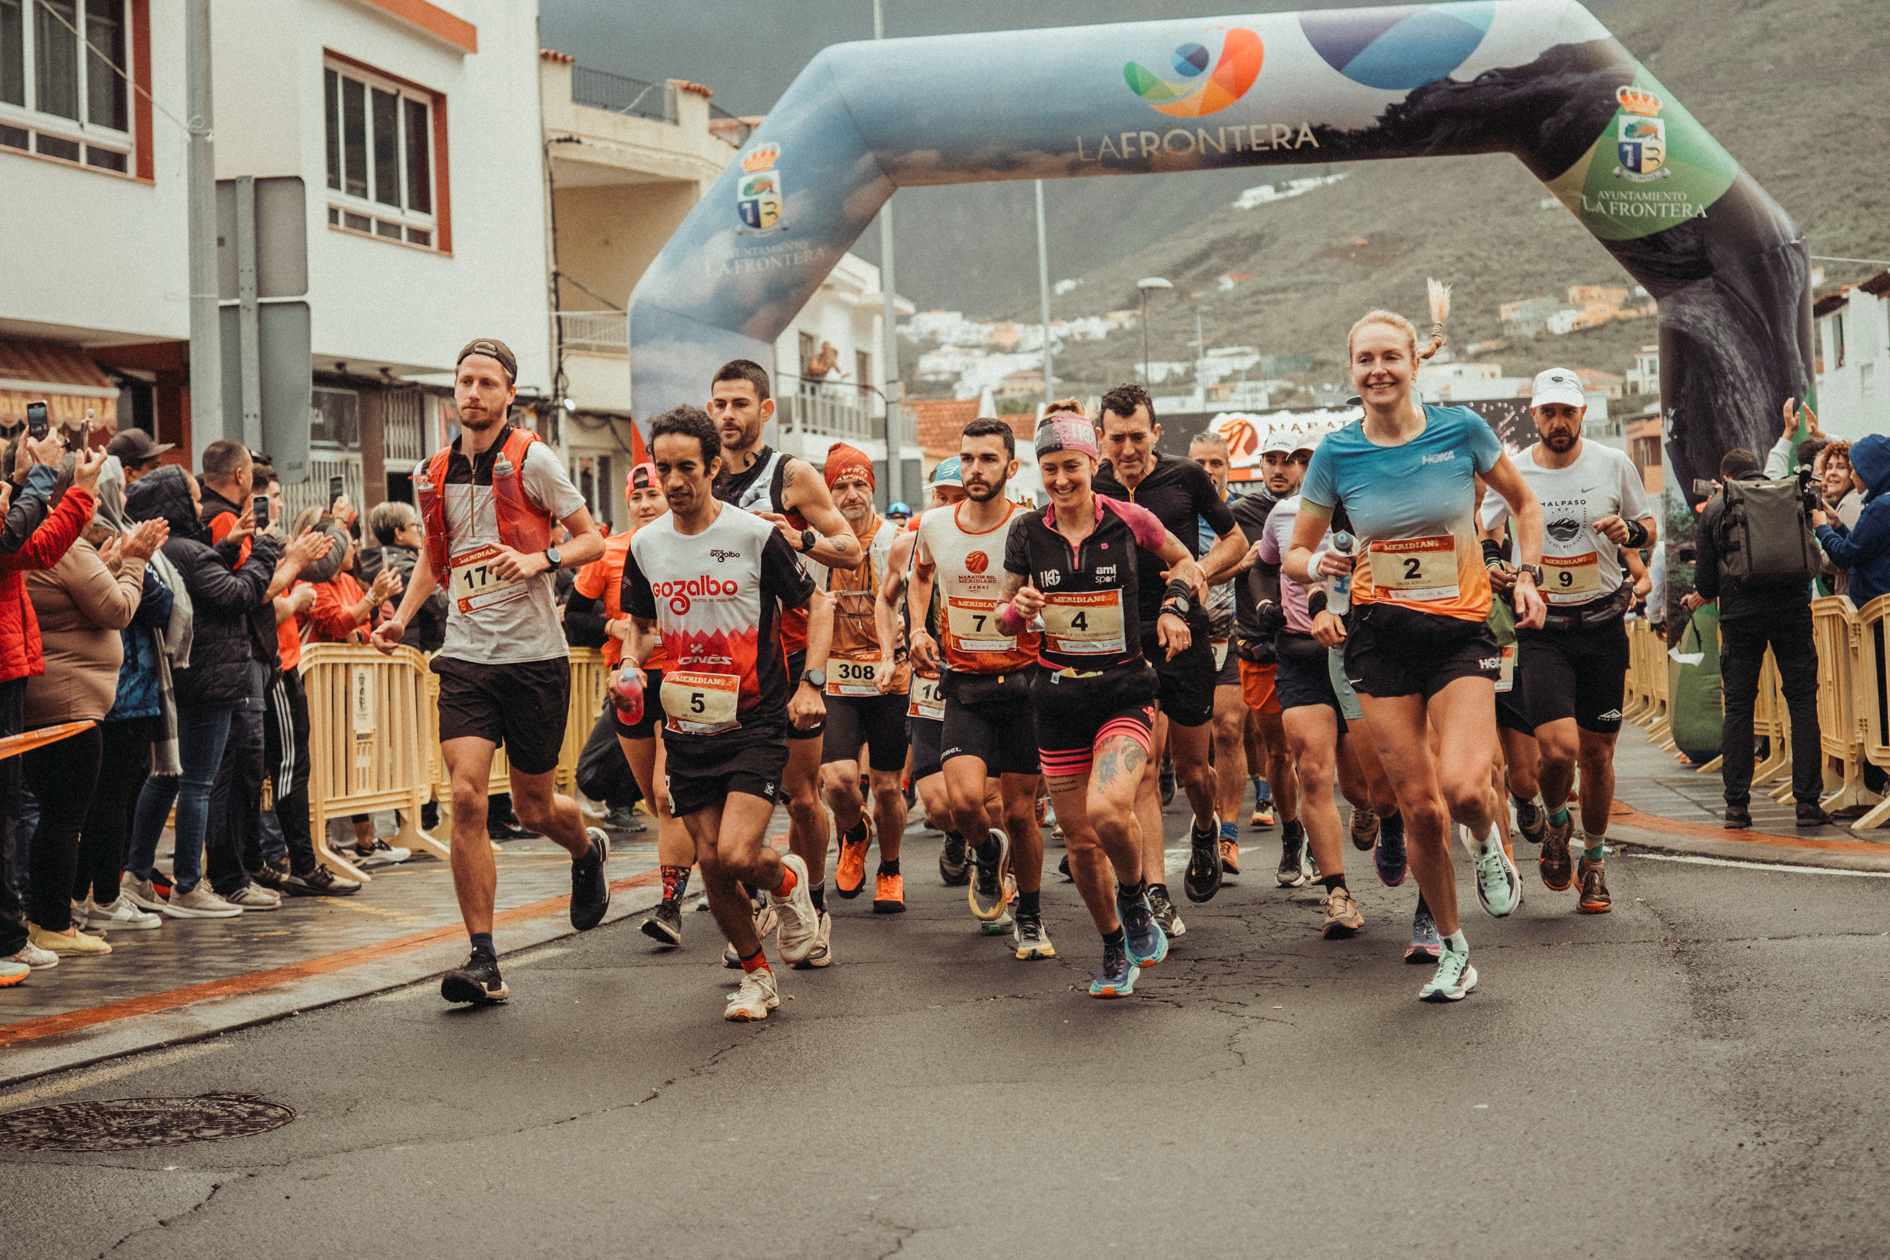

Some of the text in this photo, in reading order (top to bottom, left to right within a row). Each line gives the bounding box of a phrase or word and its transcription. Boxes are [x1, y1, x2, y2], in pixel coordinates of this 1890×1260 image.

[1598, 190, 1688, 201] AYUNTAMIENTO
[1582, 195, 1708, 218] LA FRONTERA
[1422, 450, 1456, 465] HOKA
[463, 565, 502, 589] 17
[1403, 558, 1422, 579] 2
[1095, 575, 1117, 585] sport
[1559, 571, 1573, 587] 9
[972, 614, 987, 632] 7
[1071, 611, 1089, 632] 4
[838, 664, 875, 680] 308
[690, 693, 705, 713] 5
